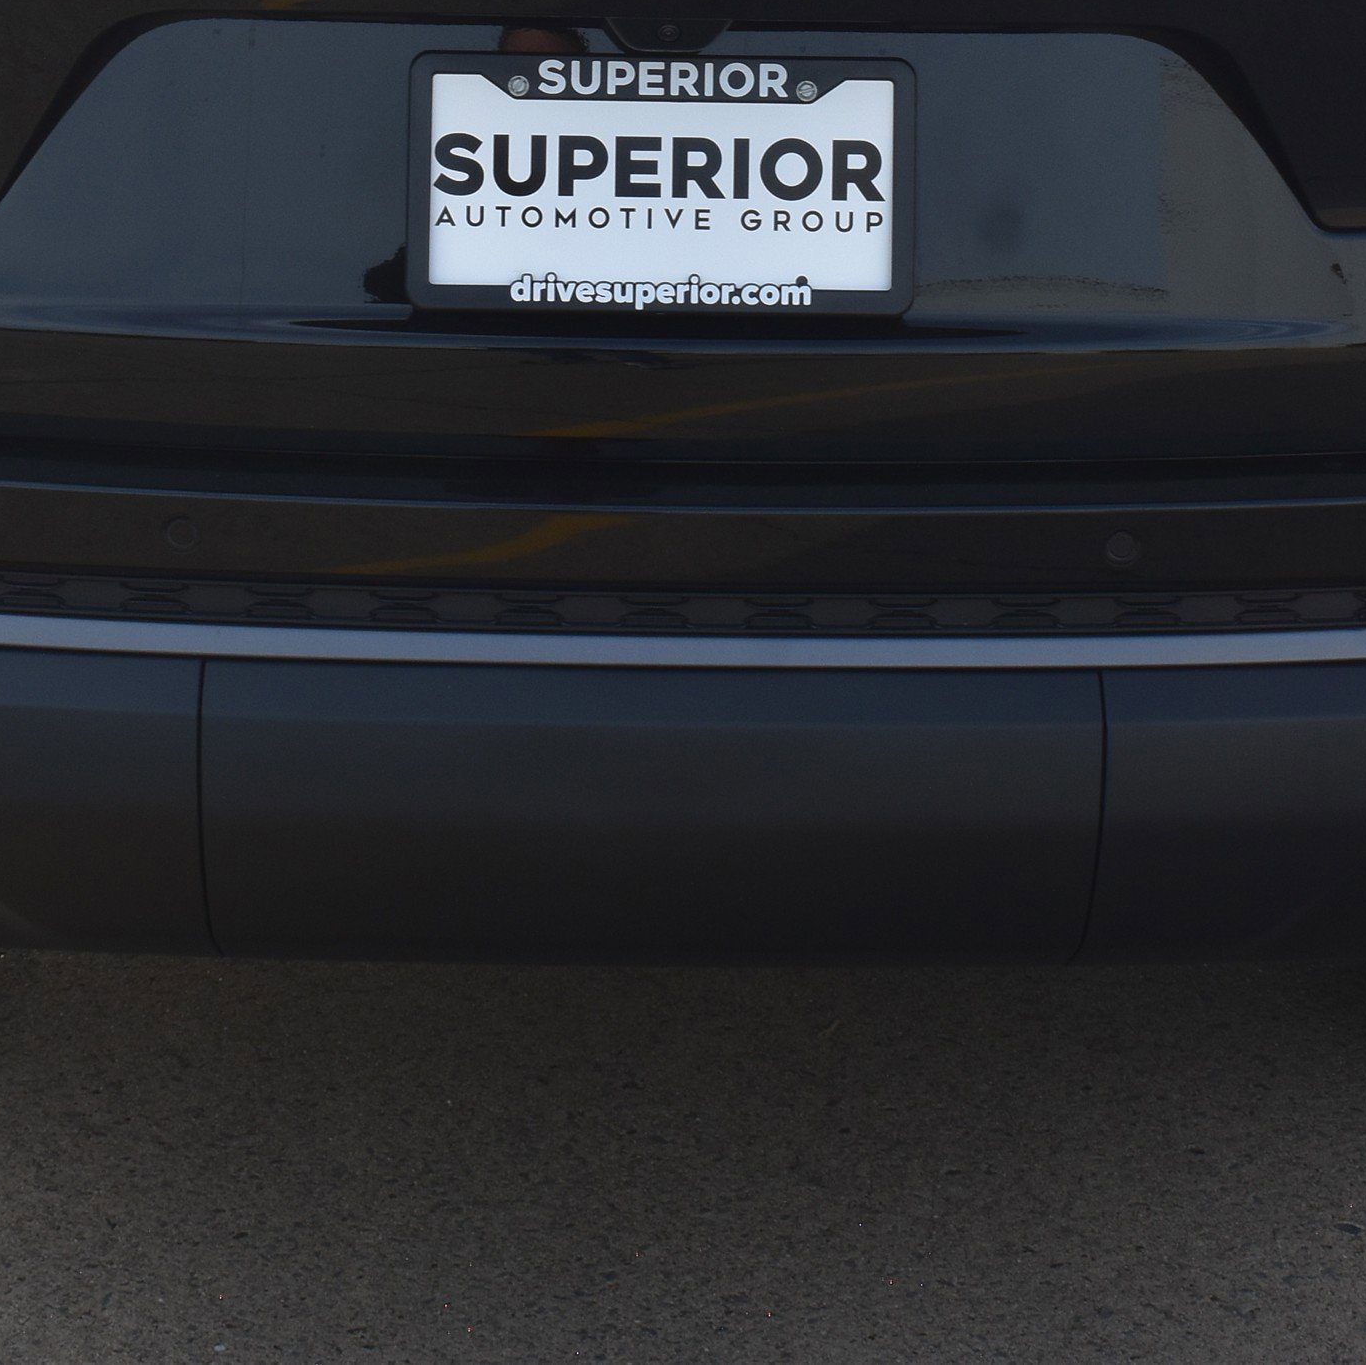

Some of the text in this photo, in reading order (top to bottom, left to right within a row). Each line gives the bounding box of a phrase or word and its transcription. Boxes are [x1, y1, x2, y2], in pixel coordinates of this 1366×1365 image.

[537, 59, 789, 98] SUPERIOR
[432, 132, 886, 202] SUPERIOR
[434, 205, 884, 234] AUTOMOTIVE GROUP
[510, 273, 812, 310] drivesuperior.com
